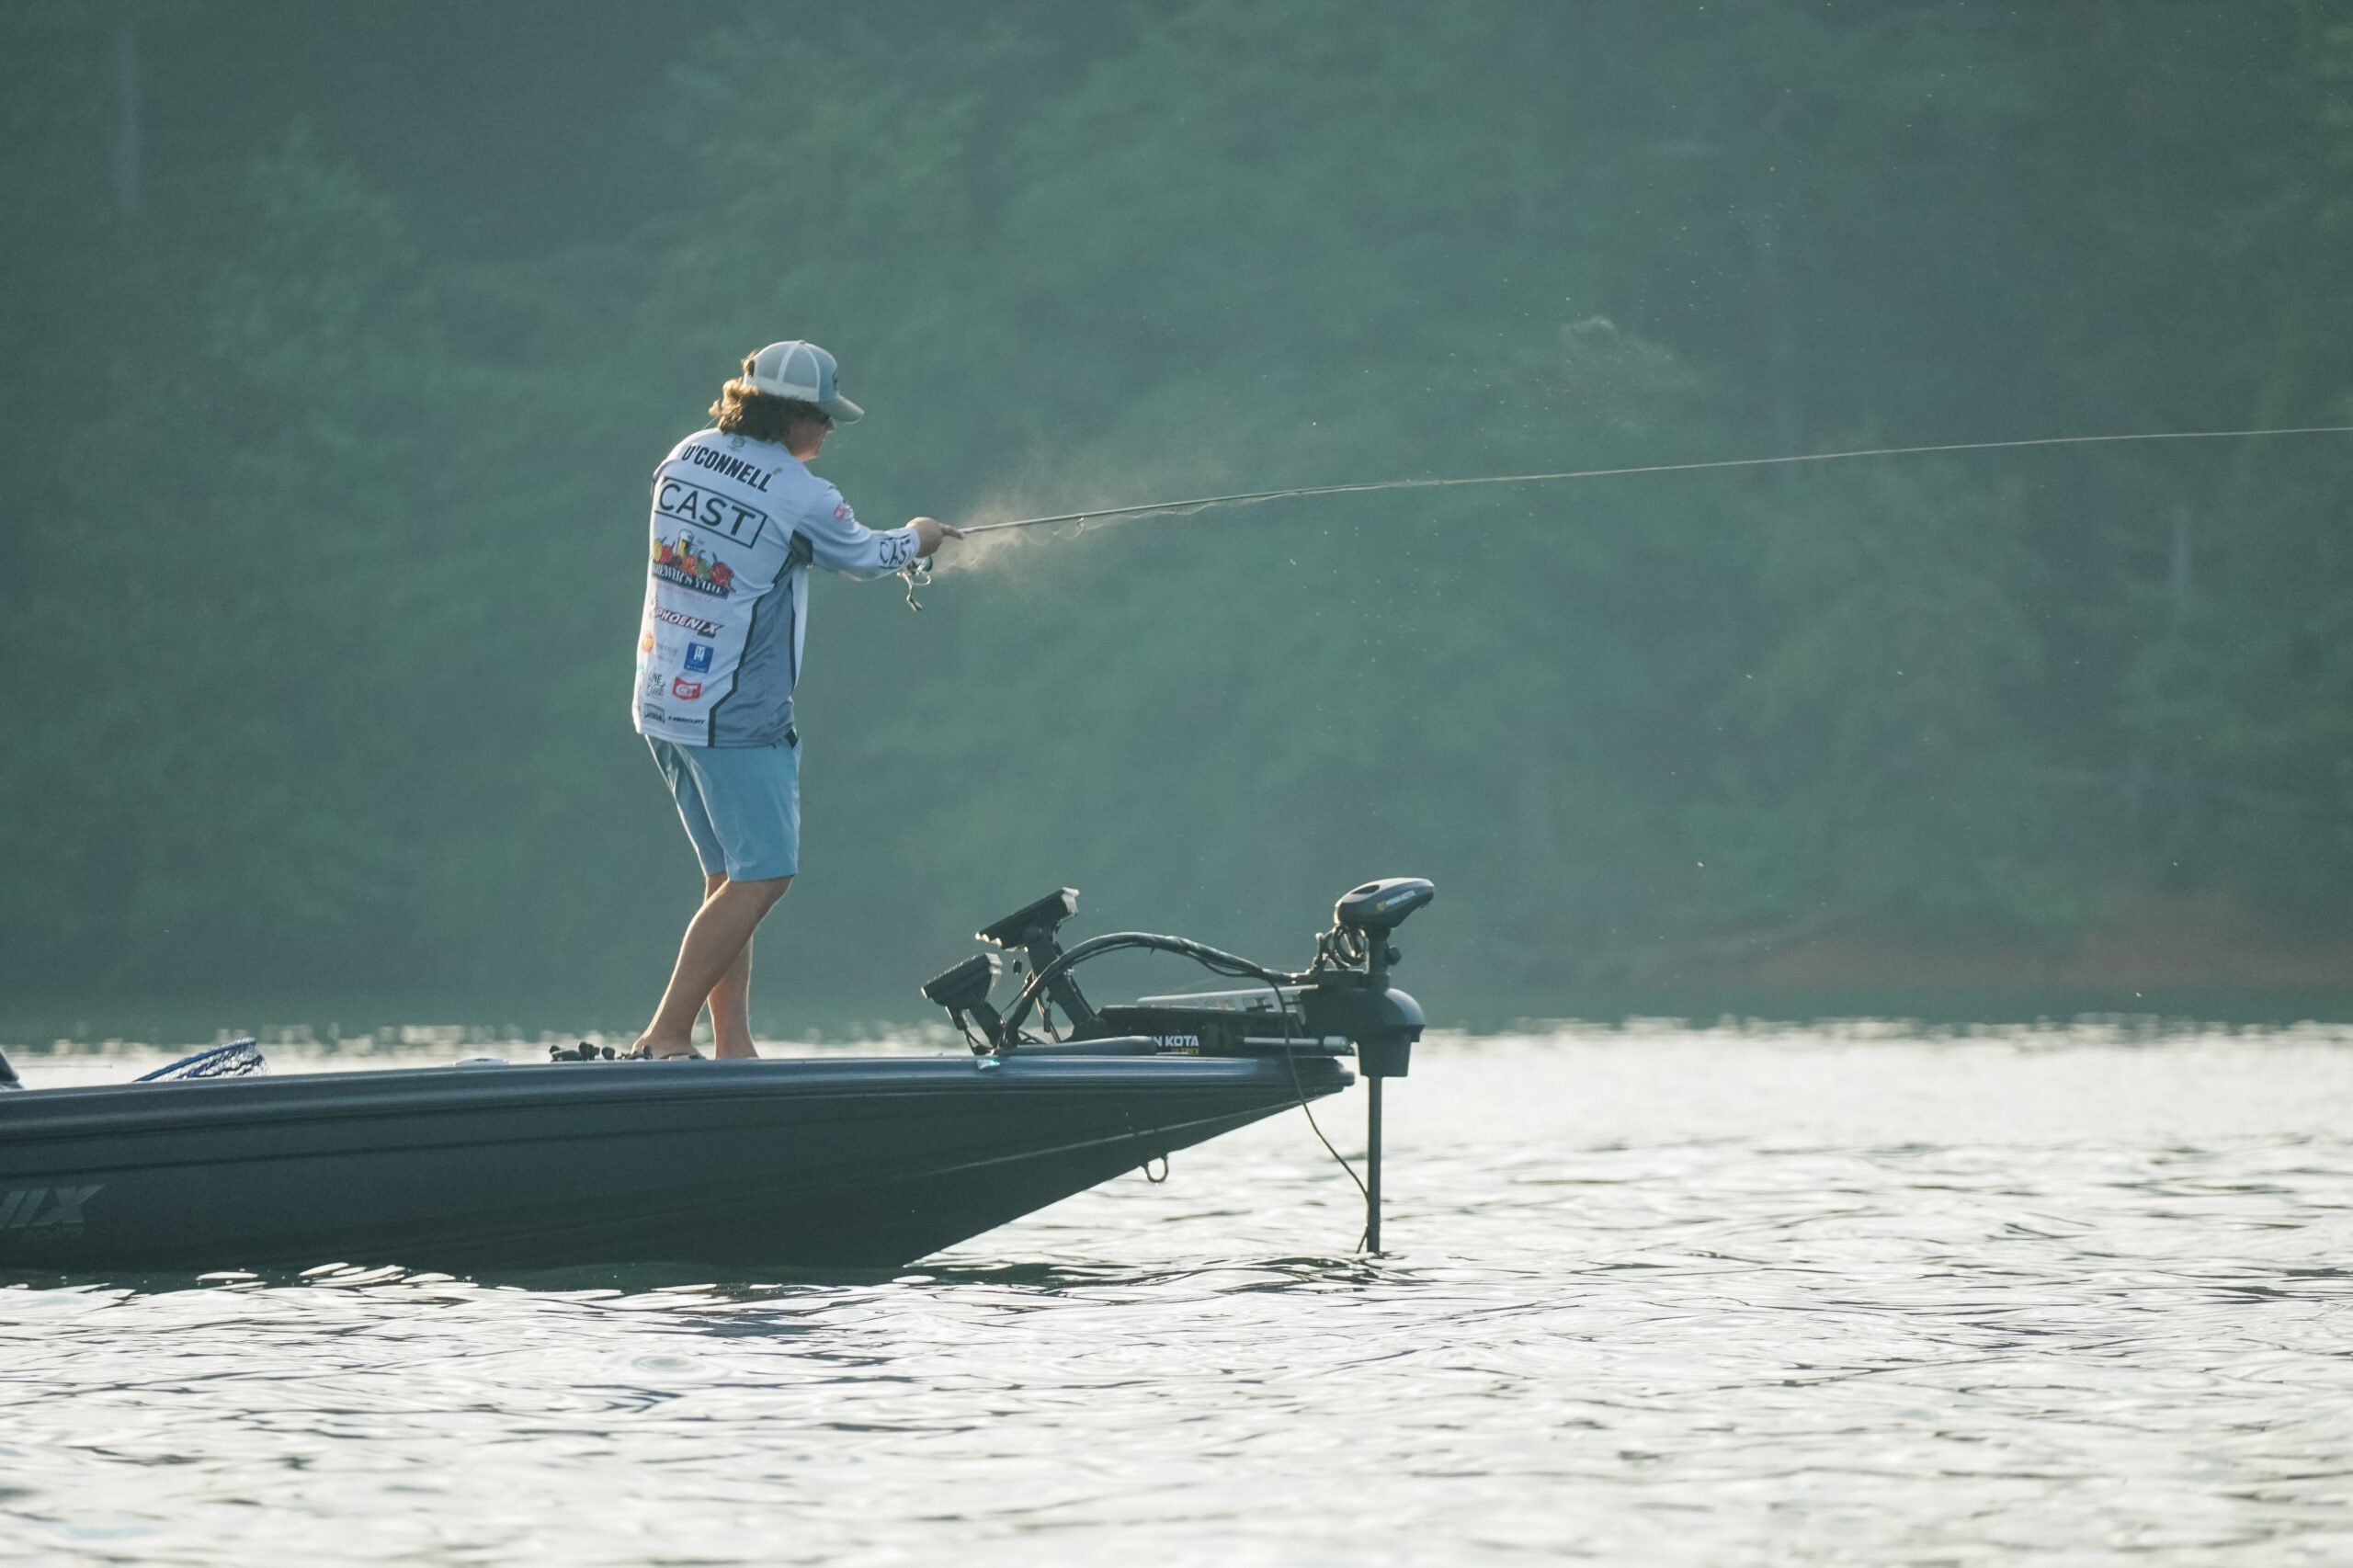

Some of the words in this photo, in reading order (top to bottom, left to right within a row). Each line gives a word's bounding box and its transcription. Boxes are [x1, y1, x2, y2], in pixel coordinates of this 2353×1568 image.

[659, 483, 756, 537] CAST
[654, 606, 724, 637] PHOENIX
[1165, 1035, 1199, 1047] KOTA
